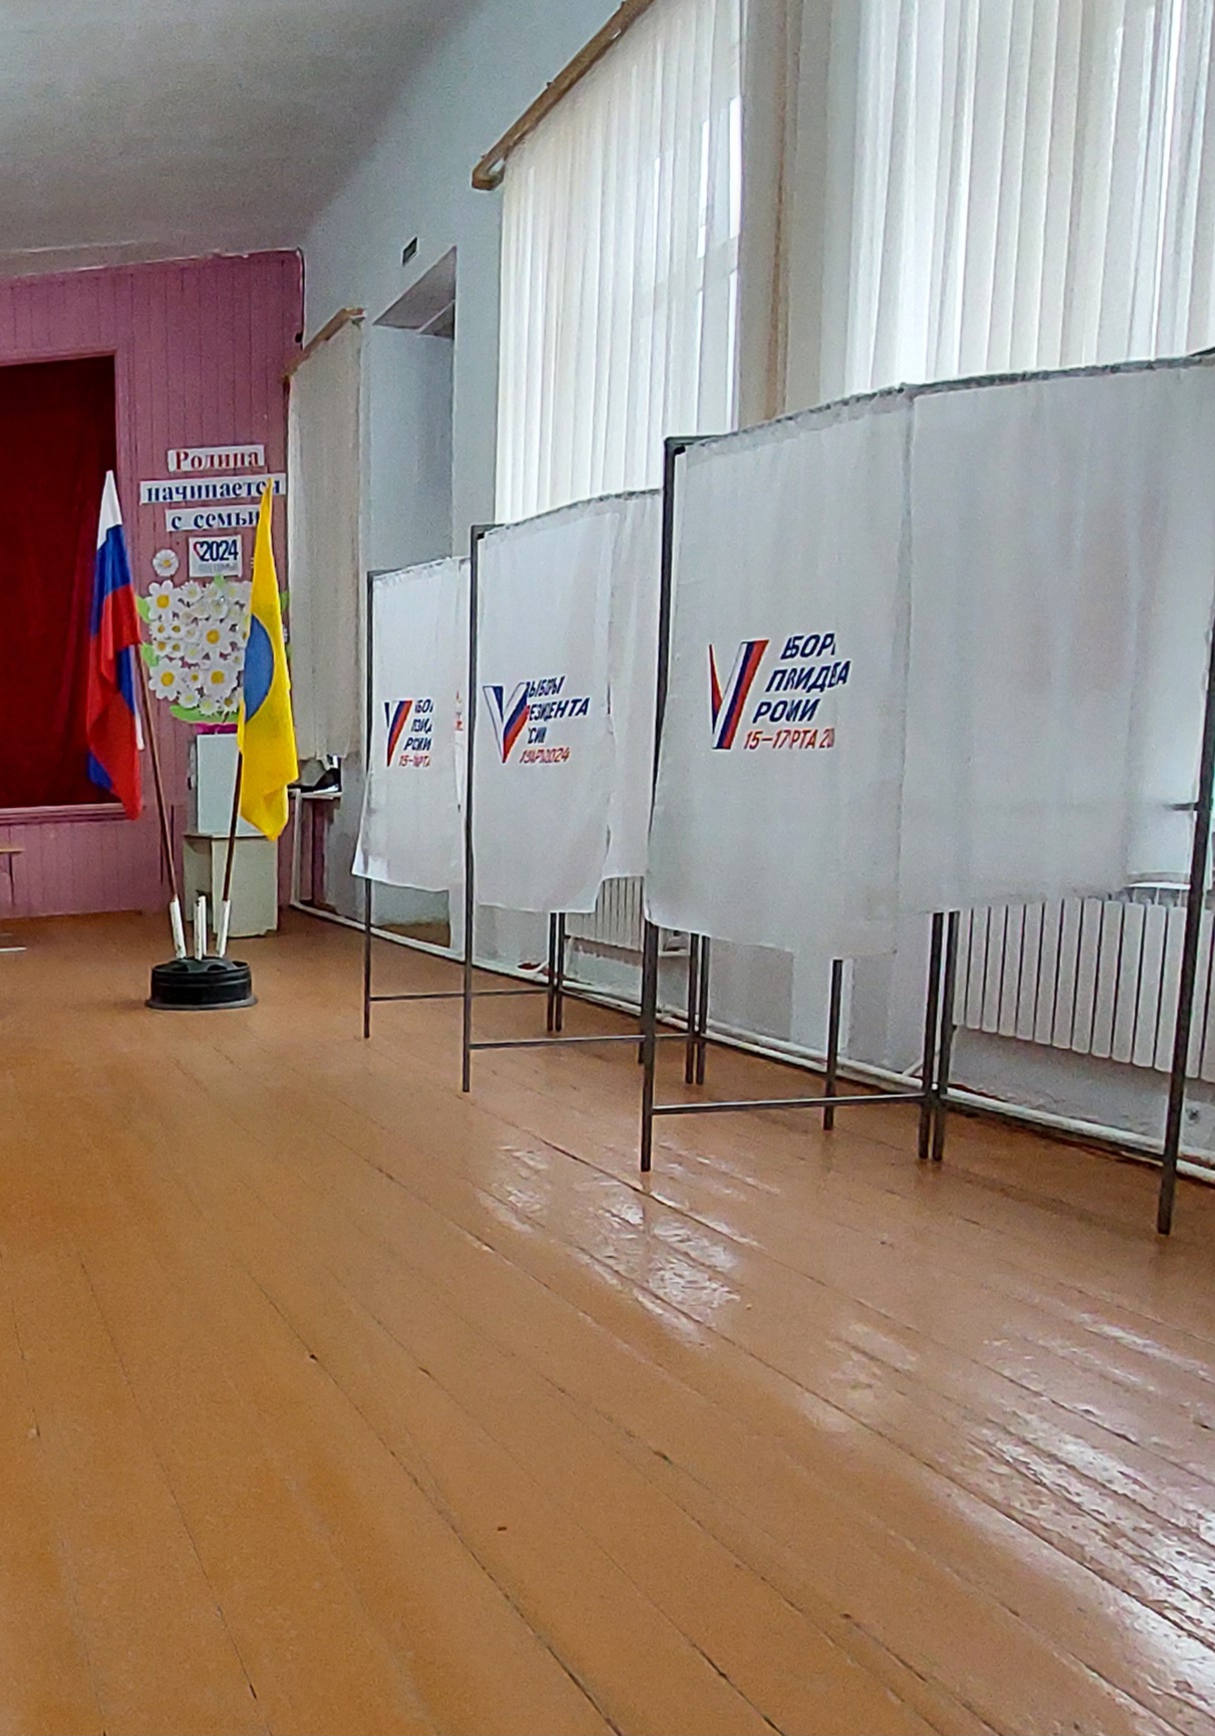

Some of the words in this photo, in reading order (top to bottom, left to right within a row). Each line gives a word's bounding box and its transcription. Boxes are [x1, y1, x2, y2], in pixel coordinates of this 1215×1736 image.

[175, 450, 260, 471] Родина
[170, 514, 183, 530] с
[197, 538, 239, 562] 2024
